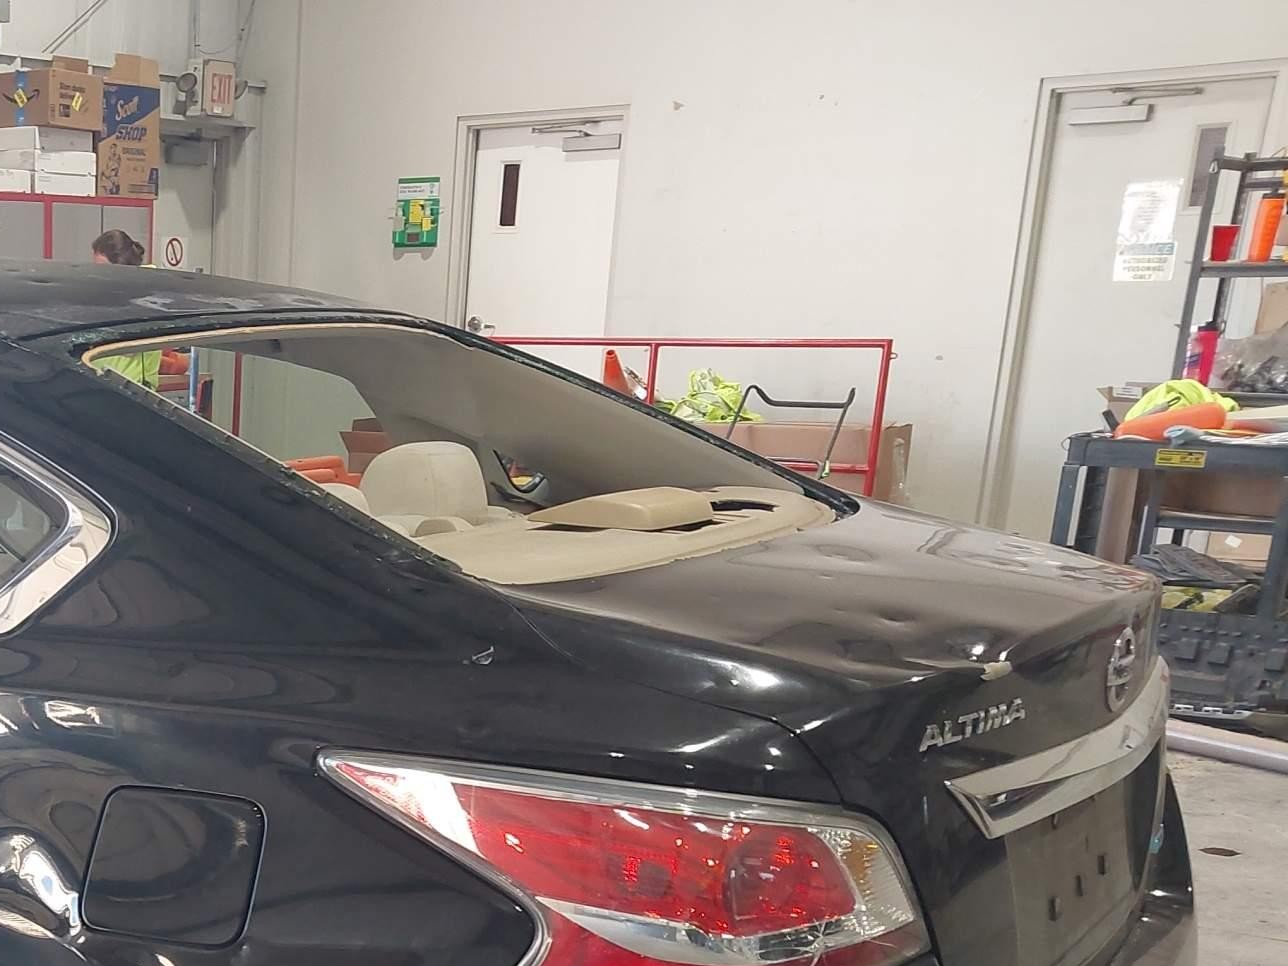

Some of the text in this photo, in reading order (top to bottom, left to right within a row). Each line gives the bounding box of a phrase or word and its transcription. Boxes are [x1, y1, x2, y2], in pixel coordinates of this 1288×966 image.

[211, 73, 233, 105] EXIT
[115, 96, 140, 121] Scott
[116, 124, 148, 142] SHOP
[919, 698, 1026, 752] ALTIMA
